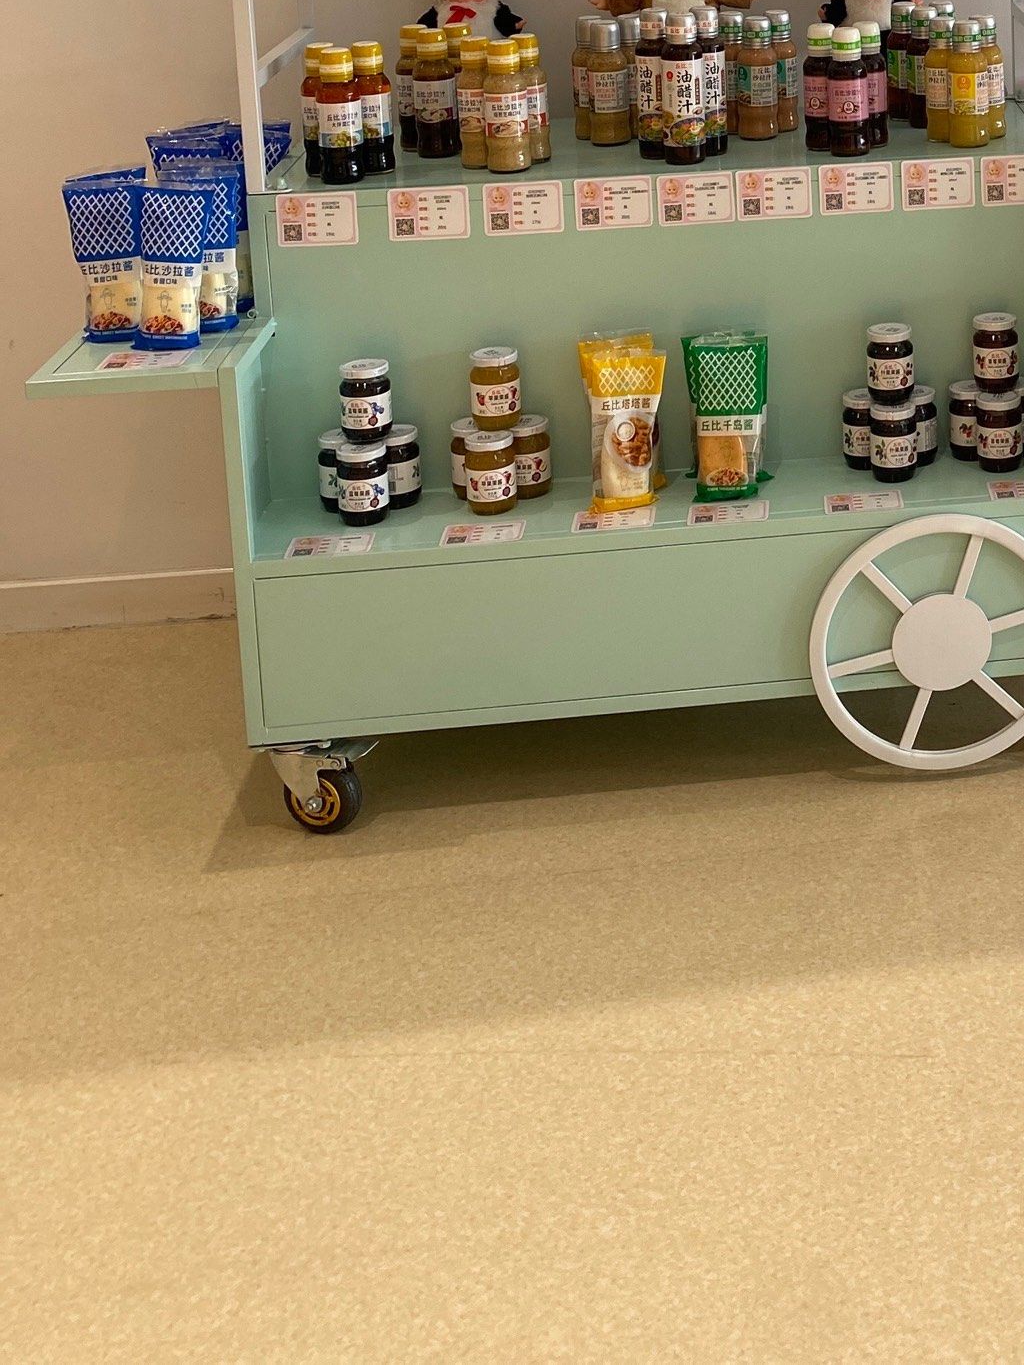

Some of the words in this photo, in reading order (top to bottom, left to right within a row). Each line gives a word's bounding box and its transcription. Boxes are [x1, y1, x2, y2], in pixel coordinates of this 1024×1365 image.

[640, 65, 654, 110] 油醋汁
[705, 61, 720, 105] 油醋汁
[677, 69, 693, 113] 油醋汁
[491, 103, 522, 111] 丘比沙拉汁
[326, 112, 358, 122] 丘比沙拉汁
[94, 275, 118, 283] 香甜口味
[601, 397, 651, 411] 丘比塔塔酱
[701, 419, 753, 431] 丘比千岛酱
